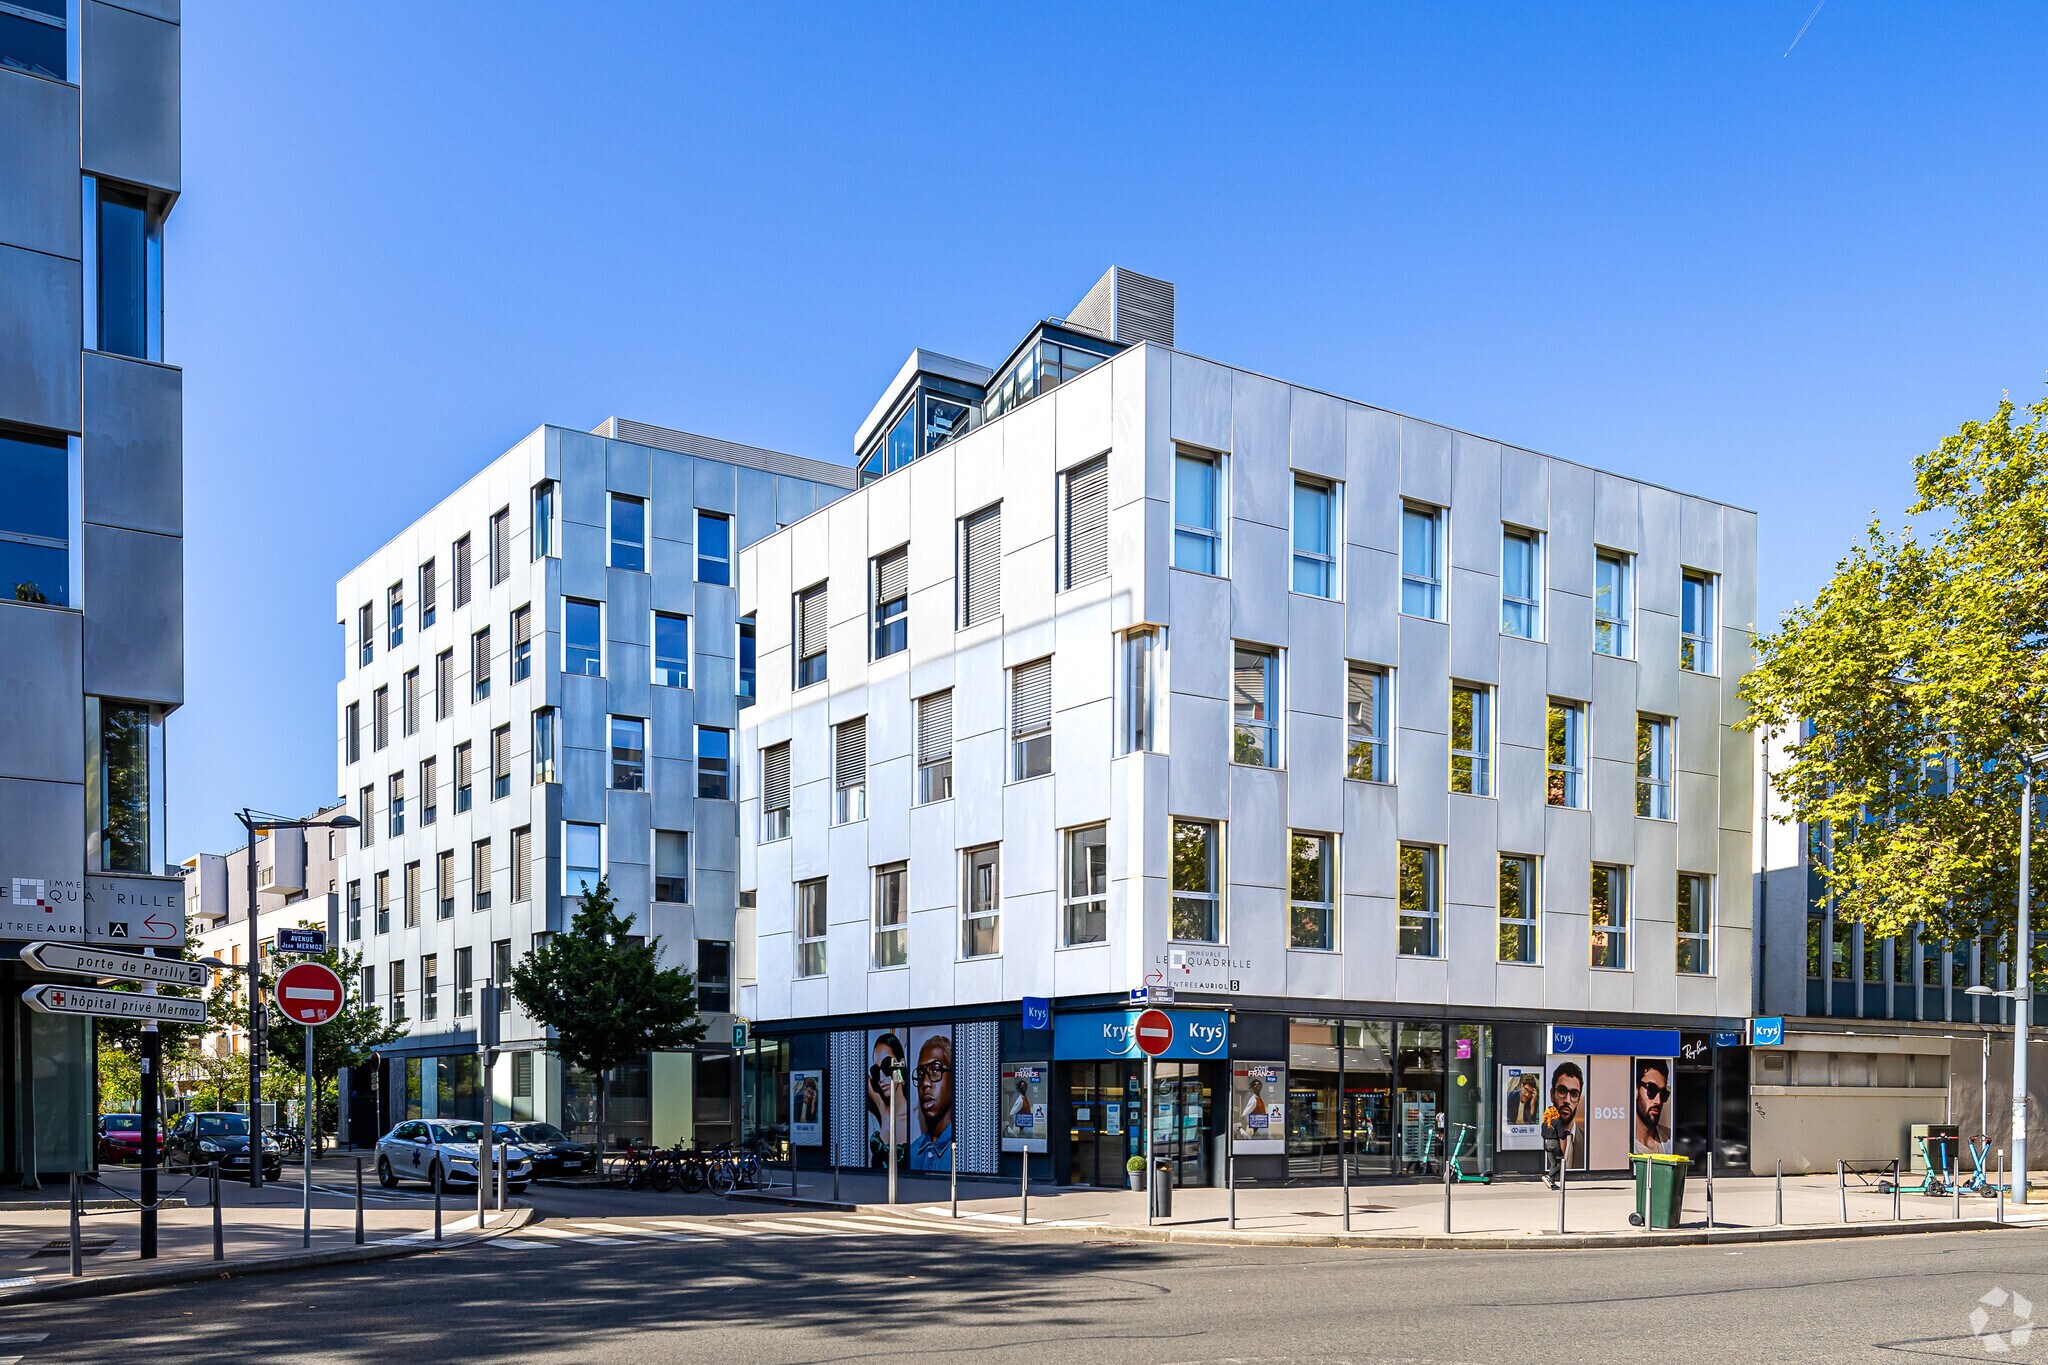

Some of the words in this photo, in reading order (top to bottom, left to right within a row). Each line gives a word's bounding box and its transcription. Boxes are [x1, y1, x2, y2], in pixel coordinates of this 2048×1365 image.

[111, 923, 127, 937] A
[291, 935, 314, 943] AVENUE
[296, 942, 323, 951] MERMOZ
[1187, 950, 1221, 958] IMMEUBLE
[77, 956, 114, 970] porte
[121, 960, 137, 973] de
[143, 963, 186, 980] Parilly
[1155, 955, 1168, 964] LE
[1187, 957, 1252, 969] QUADRILLE
[1231, 981, 1239, 991] B
[70, 994, 117, 1010] hôpital
[121, 1001, 151, 1013] privé
[156, 1004, 201, 1017] Mermoz
[1028, 1006, 1047, 1021] Krys
[735, 1028, 743, 1043] P
[1103, 1022, 1135, 1042] Krys
[1188, 1022, 1223, 1043] Krys
[1554, 1032, 1572, 1045] Krys
[1755, 1026, 1779, 1038] Krys
[1594, 1106, 1626, 1120] BOSS
